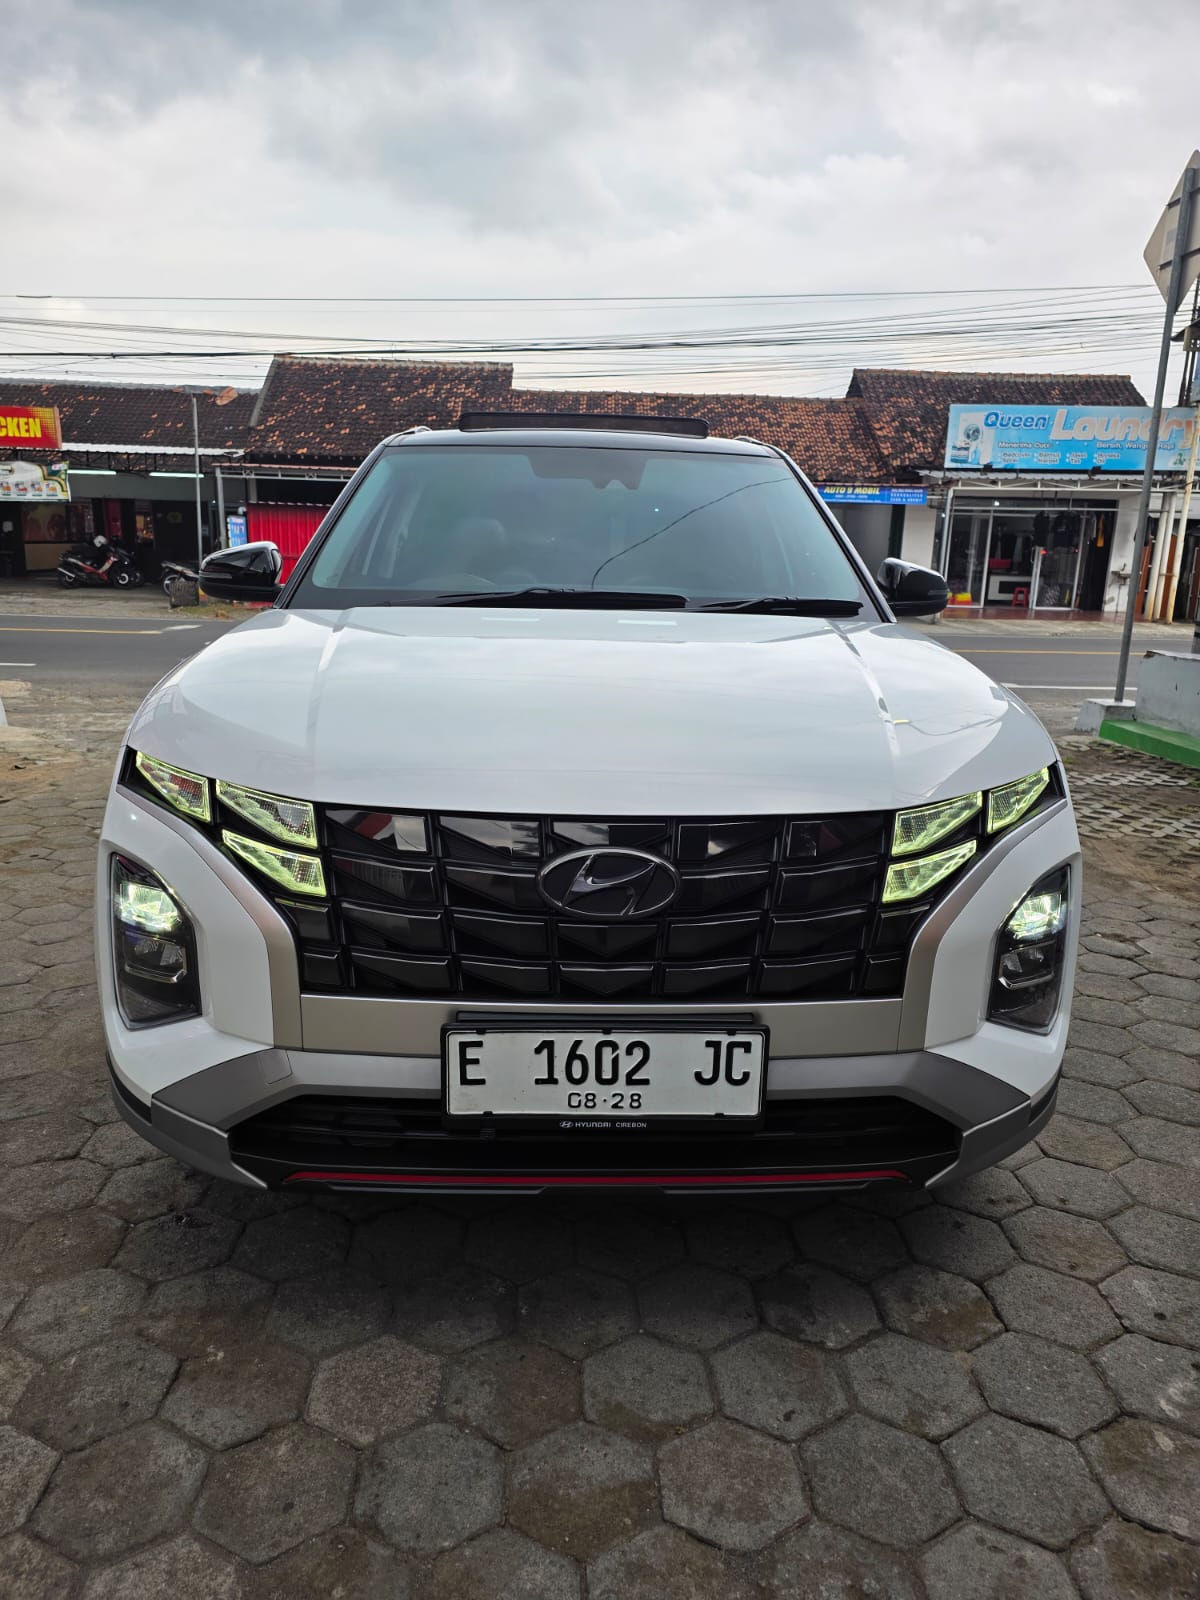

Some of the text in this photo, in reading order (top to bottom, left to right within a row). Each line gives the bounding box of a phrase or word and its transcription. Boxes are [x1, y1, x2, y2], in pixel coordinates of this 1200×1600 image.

[983, 411, 1047, 428] Queen
[458, 1039, 753, 1086] E 1602 JC
[575, 1121, 648, 1129] HYUNDAI CIREBON
